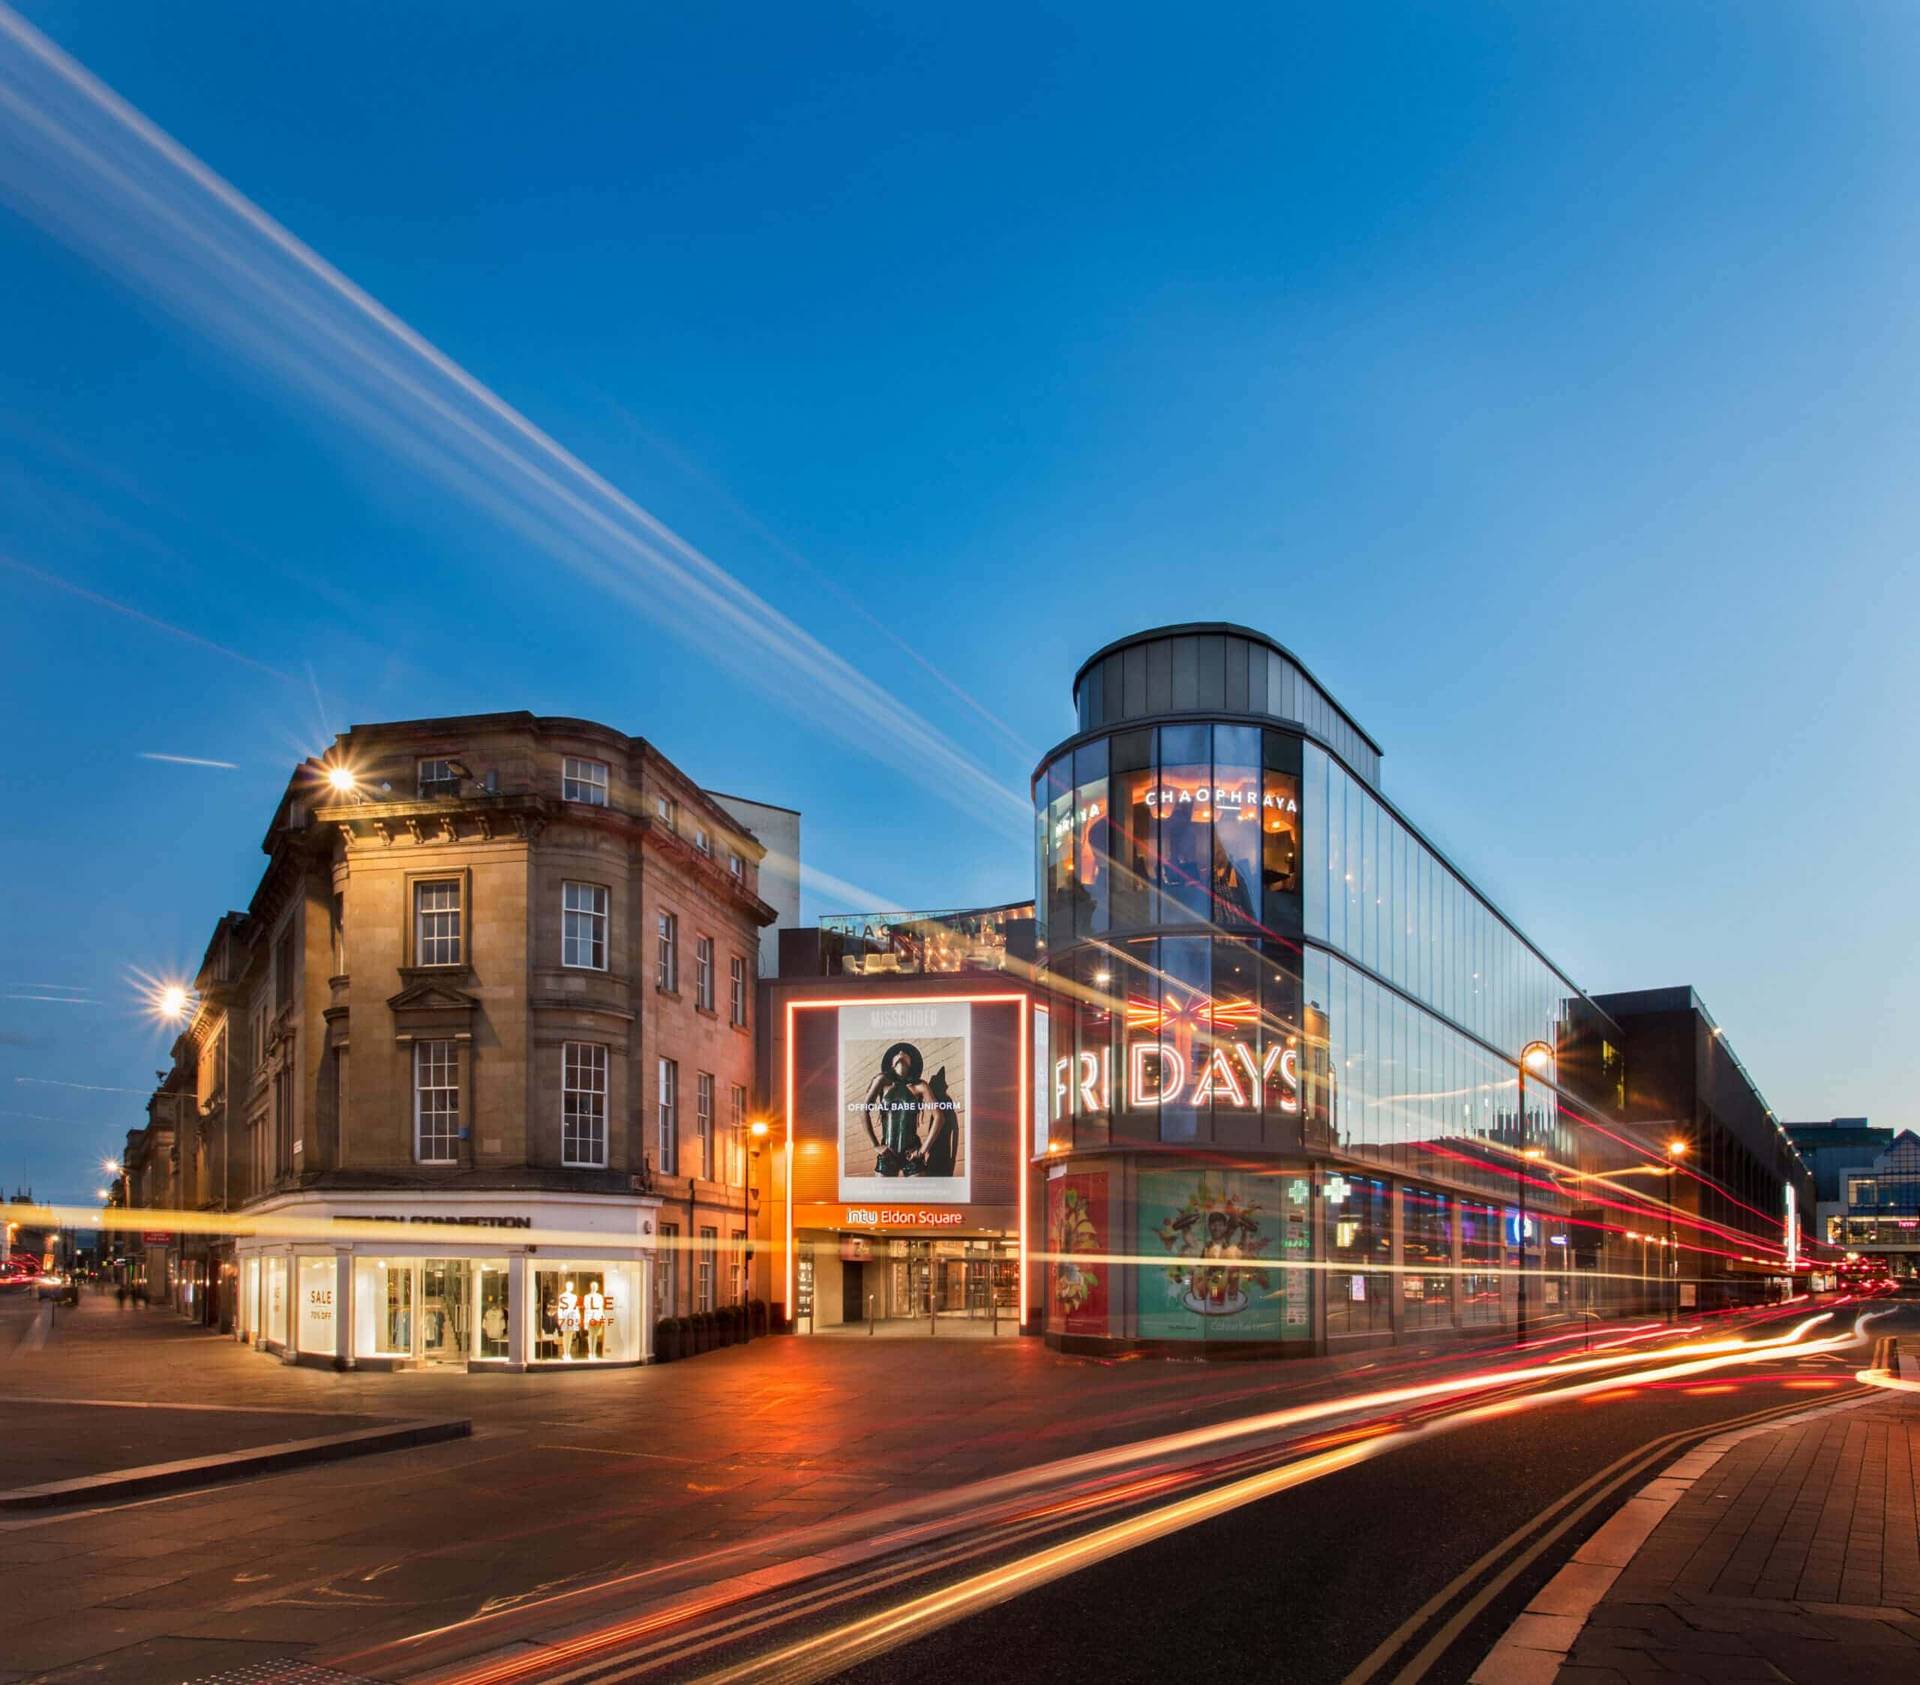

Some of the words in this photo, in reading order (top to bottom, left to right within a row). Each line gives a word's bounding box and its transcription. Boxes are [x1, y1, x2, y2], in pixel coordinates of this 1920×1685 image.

[1144, 788, 1298, 812] CHAOPHRAYA
[1053, 1042, 1298, 1119] FRIDAYS
[848, 1102, 889, 1112] OFFICIAL
[891, 1102, 915, 1111] BABE
[918, 1101, 960, 1110] UNIFORM
[847, 1208, 877, 1224] intu
[880, 1211, 915, 1223] Eldon
[918, 1210, 962, 1226] Square
[310, 1290, 332, 1304] SALE
